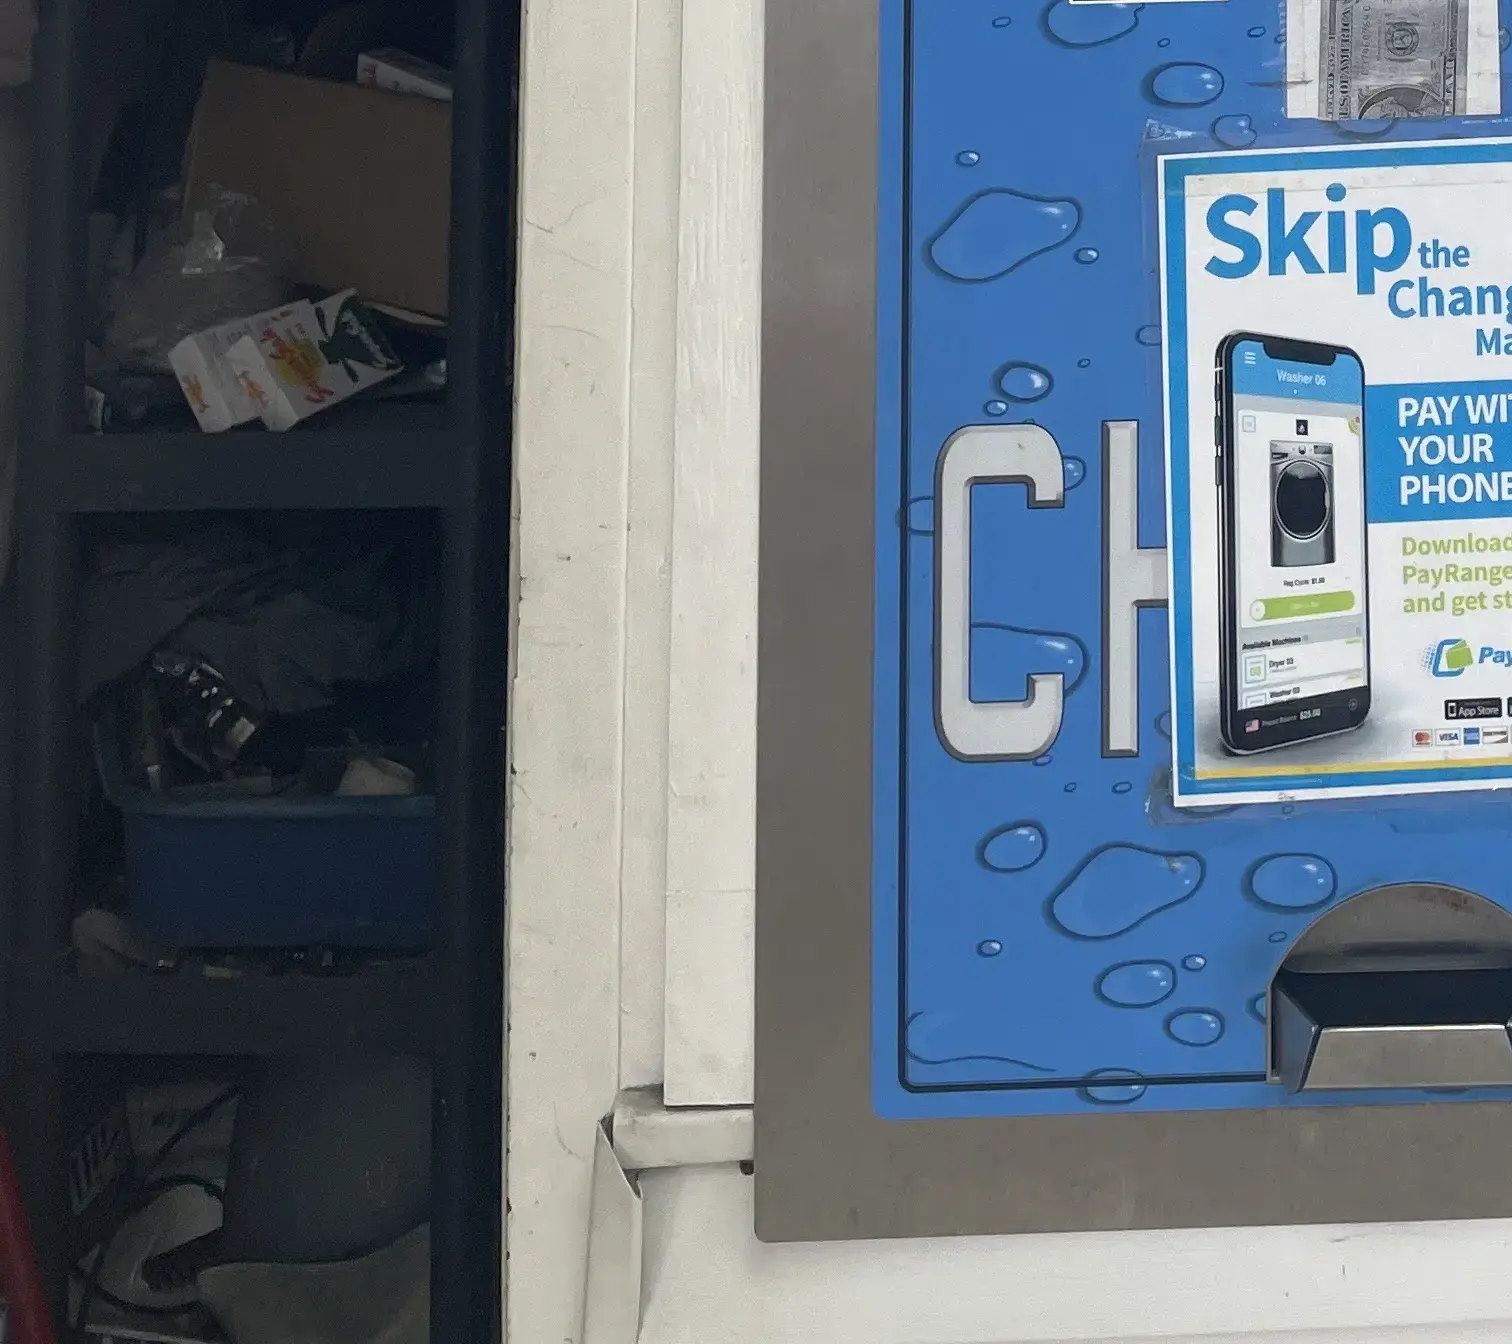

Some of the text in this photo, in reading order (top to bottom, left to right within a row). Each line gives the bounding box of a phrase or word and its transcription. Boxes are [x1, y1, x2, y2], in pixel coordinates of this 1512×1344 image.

[1204, 183, 1470, 295] Skip the
[1399, 397, 1462, 427] PAY
[1399, 433, 1494, 466] YOUR
[1403, 592, 1445, 613] and
[1451, 592, 1489, 616] get
